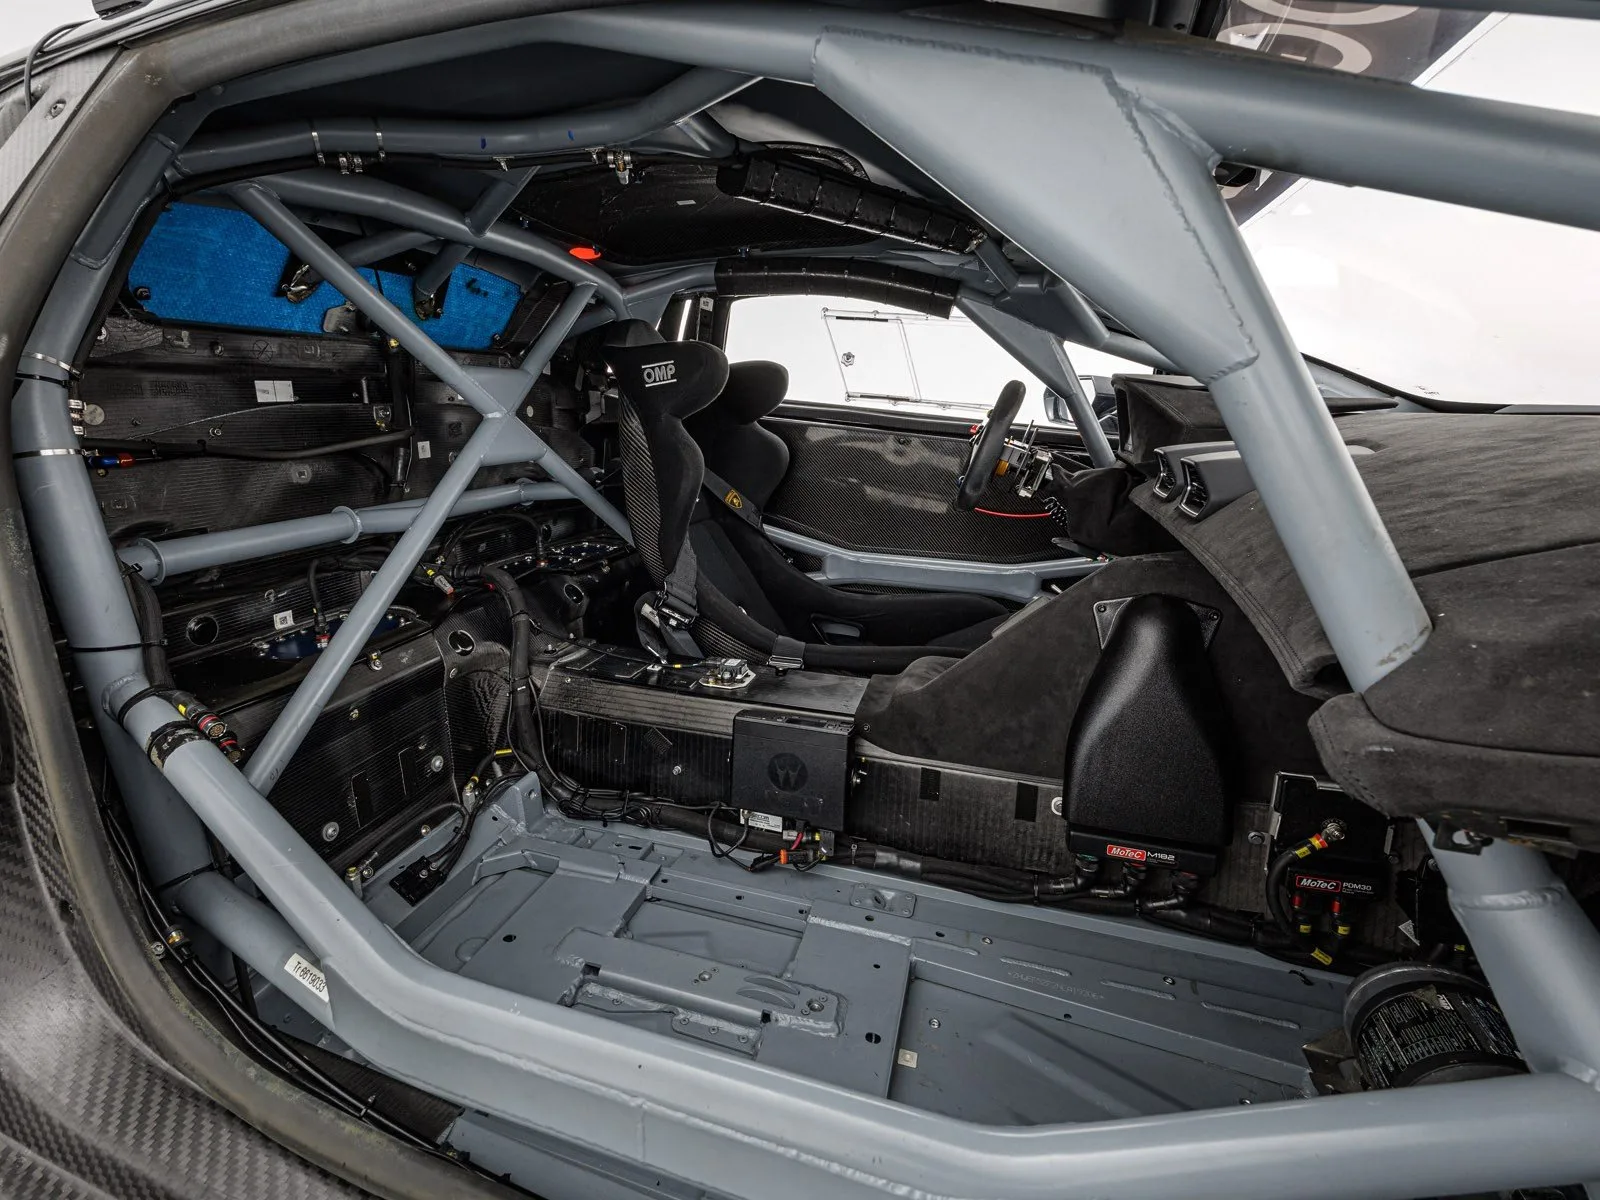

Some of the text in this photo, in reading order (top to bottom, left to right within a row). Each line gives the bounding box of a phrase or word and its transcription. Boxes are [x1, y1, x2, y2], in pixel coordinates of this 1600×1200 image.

[643, 364, 676, 383] OMP
[1110, 847, 1143, 859] MoTeC
[1300, 878, 1338, 890] MoTeC
[1342, 882, 1373, 891] PDM30
[293, 961, 302, 973] Tr
